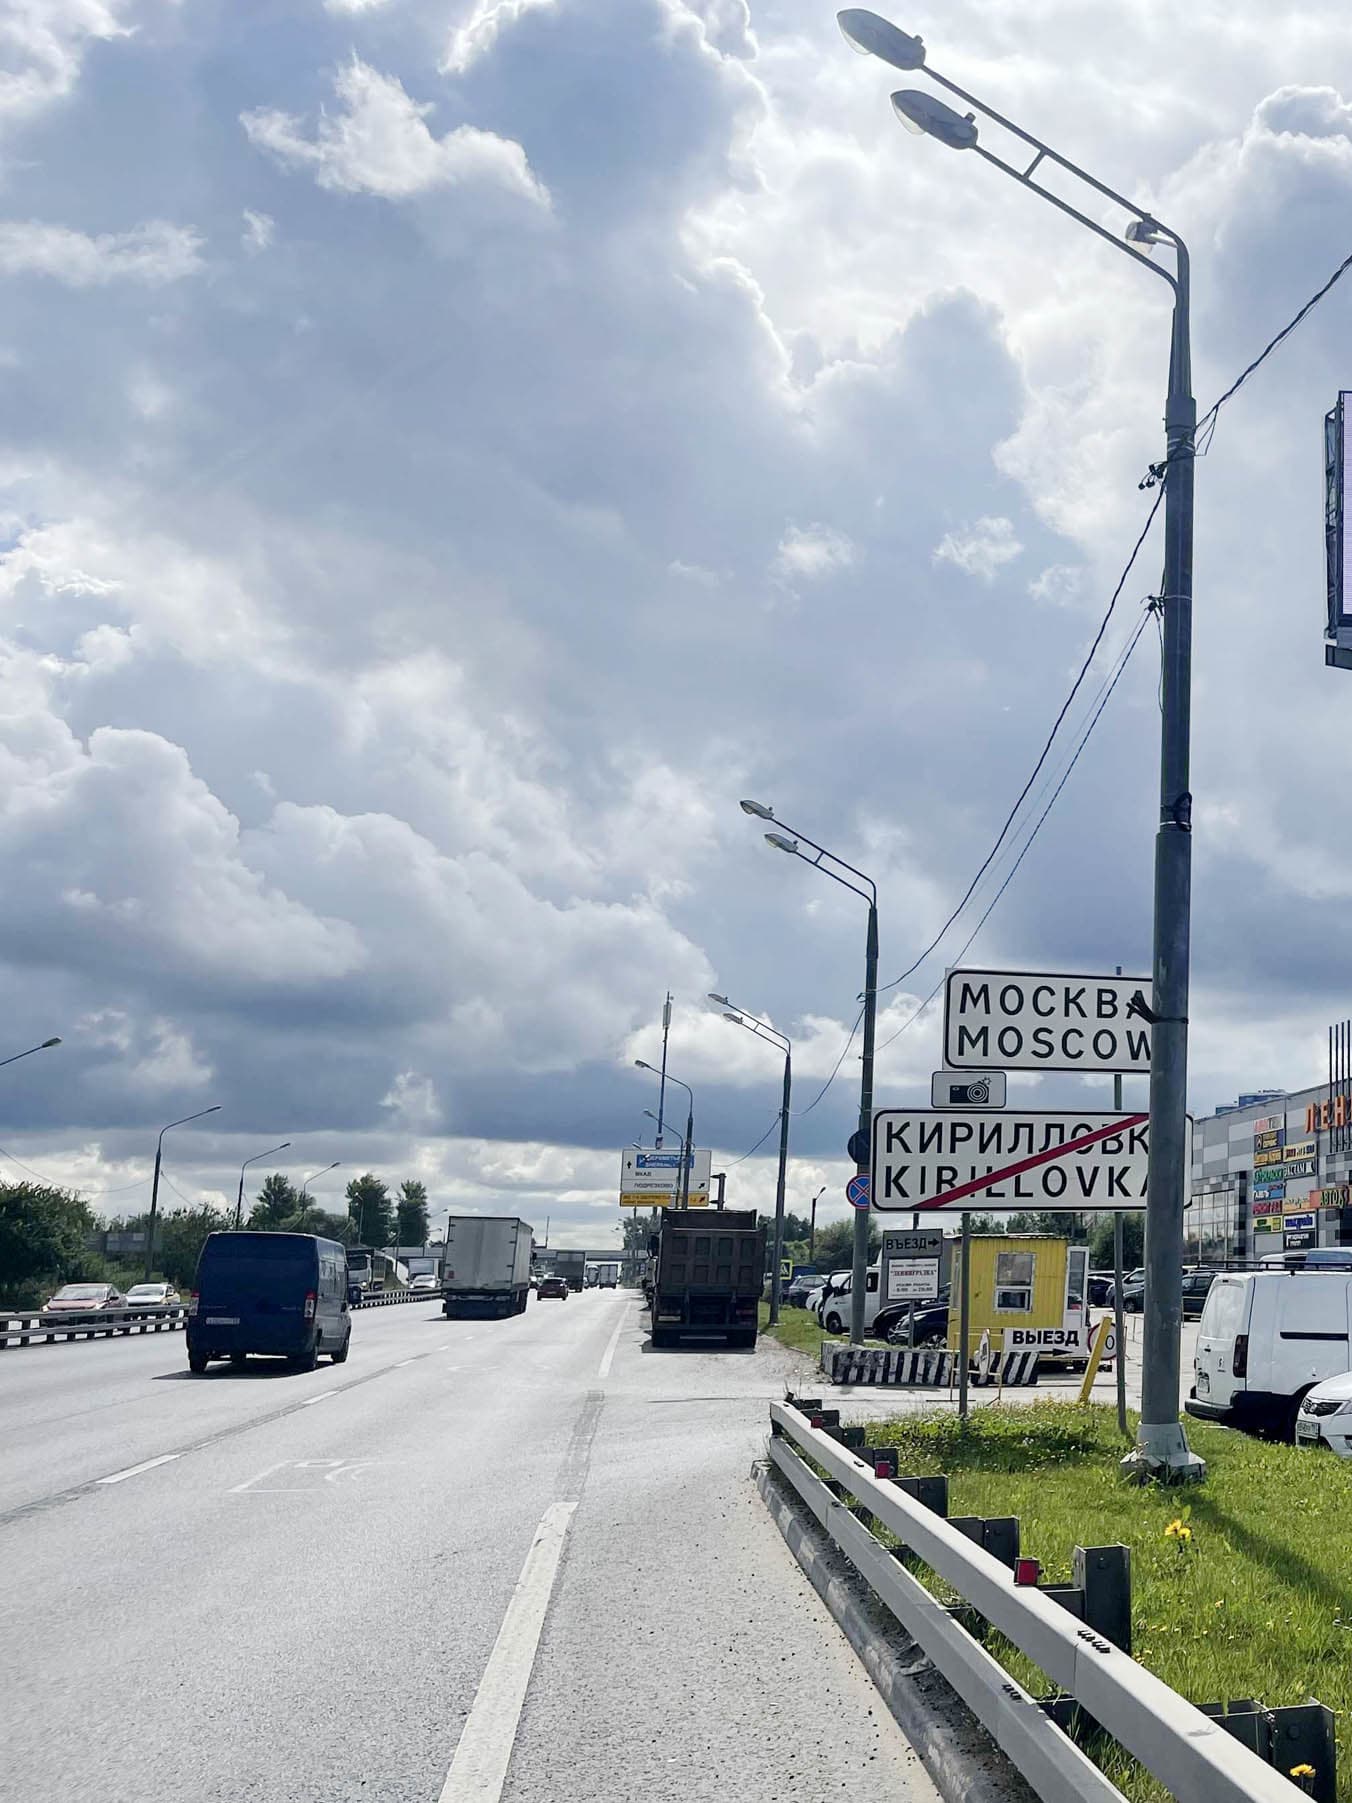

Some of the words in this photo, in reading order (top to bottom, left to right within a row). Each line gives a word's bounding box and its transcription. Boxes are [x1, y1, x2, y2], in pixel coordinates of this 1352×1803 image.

[959, 983, 1152, 1019] МОСКВА
[886, 1122, 1150, 1155] КИРИЛЛОВК
[884, 1165, 1149, 1198] KIRILLOVK
[886, 1238, 927, 1250] ВЪЕЗД
[1012, 1330, 1079, 1347] ВЫЕЗД
